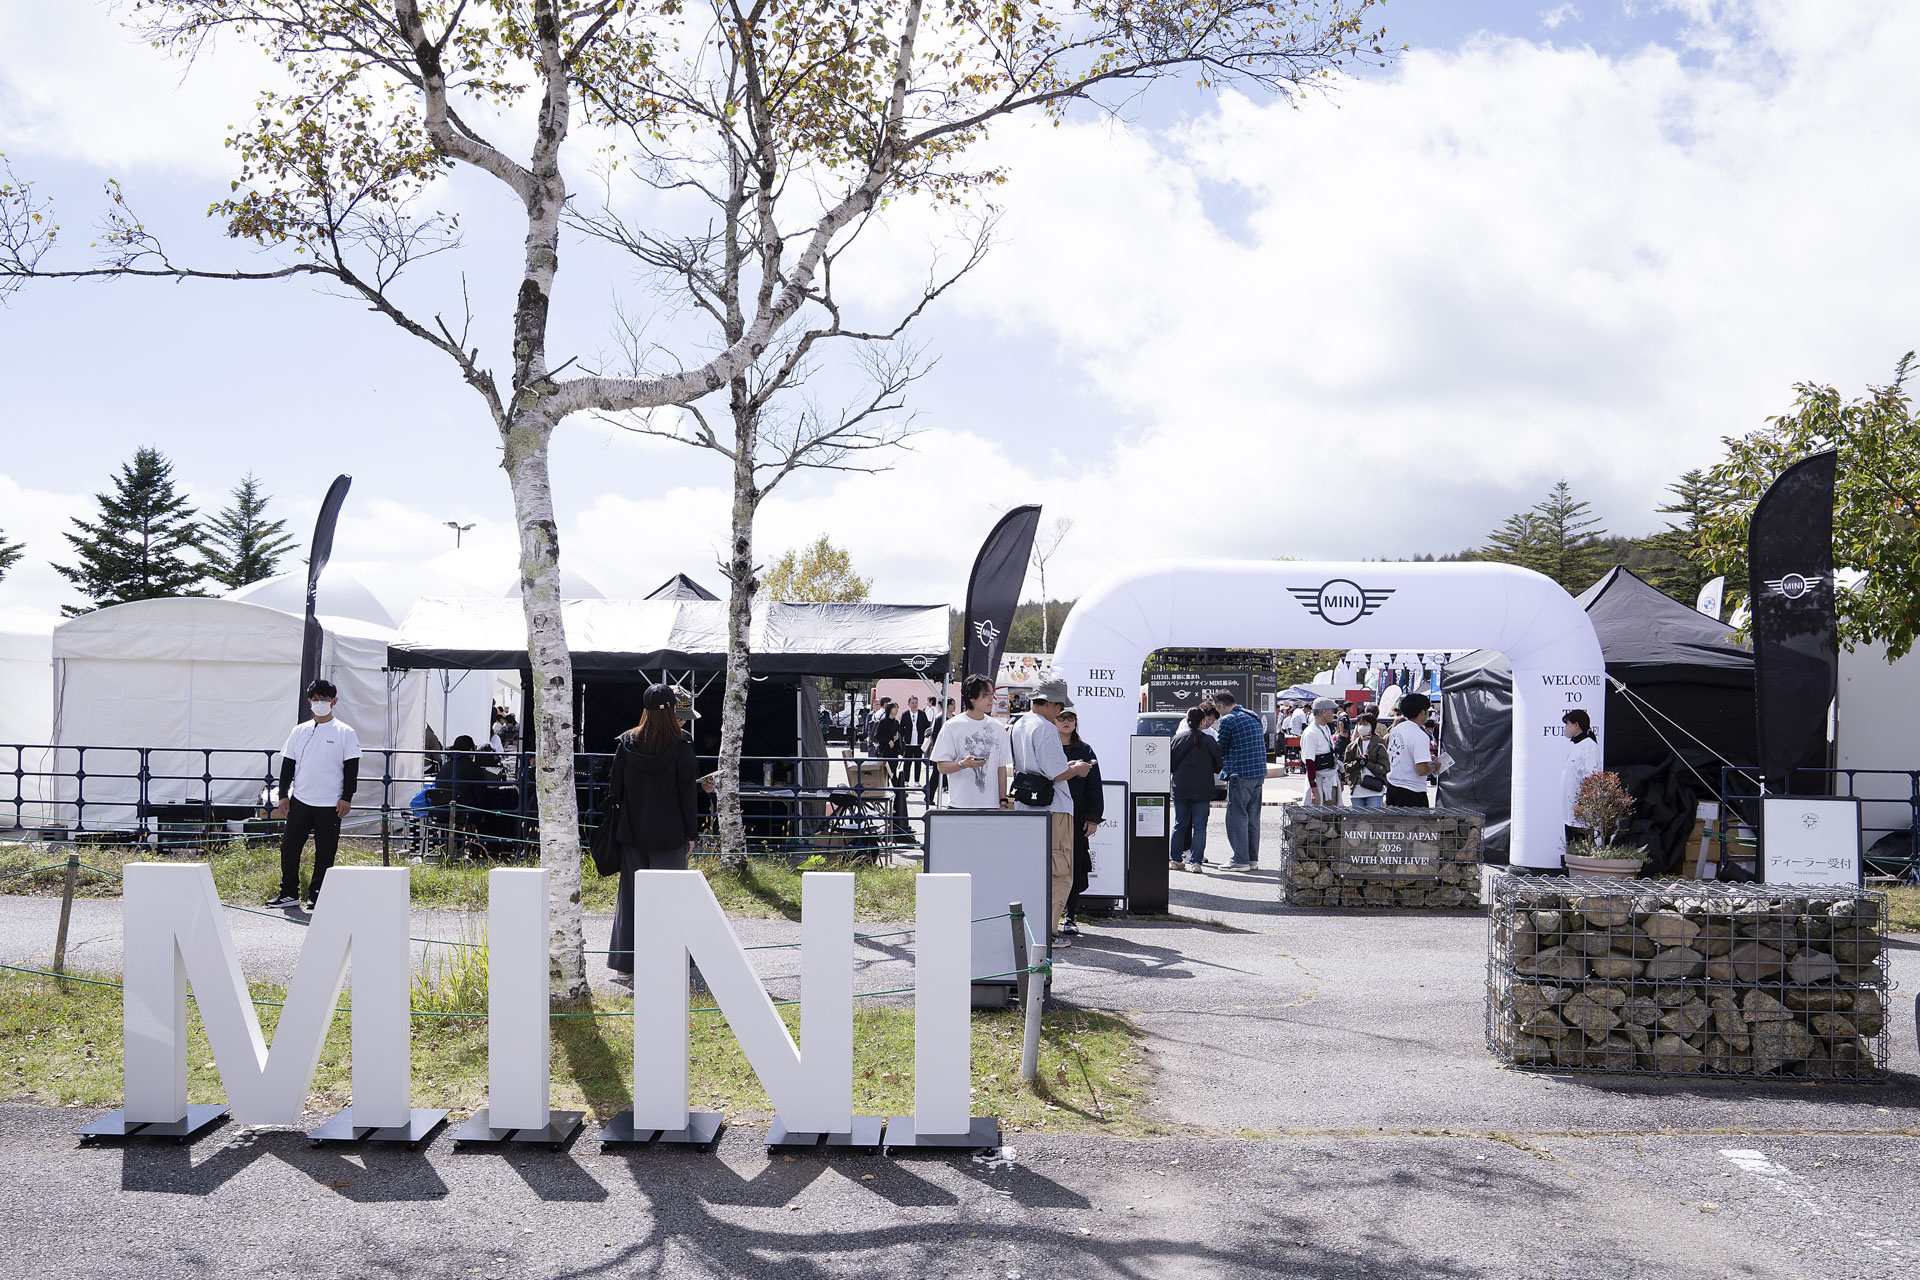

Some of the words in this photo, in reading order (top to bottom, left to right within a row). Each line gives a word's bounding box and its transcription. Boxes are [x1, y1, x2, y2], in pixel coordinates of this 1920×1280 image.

[1784, 582, 1803, 590] MINI
[1324, 595, 1359, 608] MINI
[1089, 669, 1116, 680] HEY
[1542, 675, 1600, 686] WELCOME
[1077, 686, 1125, 698] FRIEND.
[1565, 692, 1582, 702] TO
[1344, 831, 1367, 840] MINI
[1369, 831, 1405, 840] UNITED
[1406, 832, 1438, 841] JAPAN
[1380, 844, 1402, 852] 2026
[1351, 856, 1377, 864] WITH
[1380, 857, 1402, 865] MINI
[1404, 857, 1430, 865] LIVE!
[1771, 856, 1851, 869] ディーラー受付
[123, 861, 972, 1134] MINI
